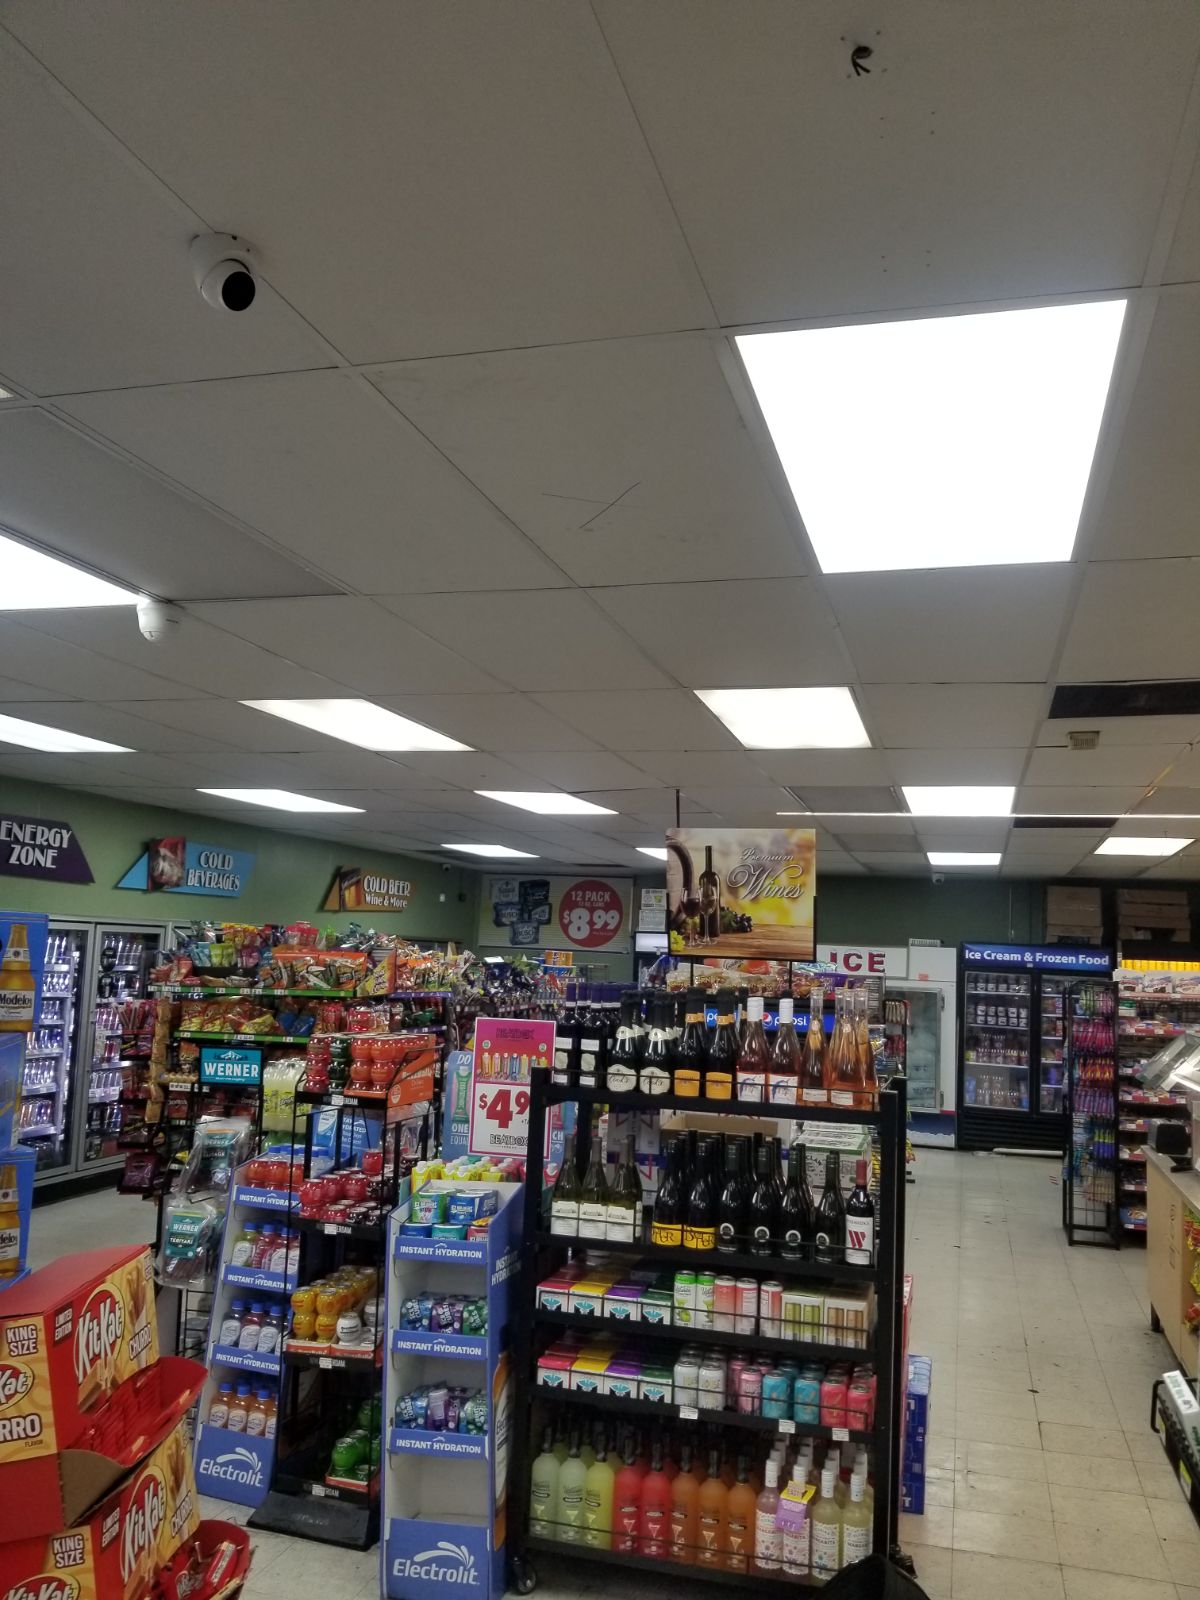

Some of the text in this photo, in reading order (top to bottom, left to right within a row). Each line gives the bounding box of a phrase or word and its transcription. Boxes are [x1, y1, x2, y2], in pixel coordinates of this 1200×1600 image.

[0, 821, 73, 848] ENERGY
[9, 844, 58, 868] ZONE
[200, 851, 234, 870] COLD
[739, 848, 794, 861] Premium
[187, 869, 240, 891] BEVERAGES
[364, 875, 411, 896] COLD BEER
[726, 864, 804, 900] Wines
[365, 893, 382, 906] Wine
[390, 896, 408, 908] More
[571, 890, 611, 902] 12 PACK
[829, 950, 886, 974] ICE
[965, 949, 1110, 965] Ice Cream & Frozen Food
[456, 1054, 472, 1065] DO
[204, 1062, 259, 1077] WERNER
[452, 1122, 469, 1134] ONE
[239, 1194, 266, 1203] INSTANT
[173, 1223, 200, 1233] WERNER
[400, 1245, 482, 1259] INSTANT HYDRATION
[227, 1274, 254, 1285] INSTANT
[55, 1308, 73, 1327] LIMITED
[6, 1325, 37, 1343] KING
[9, 1340, 37, 1357] SIZE
[398, 1341, 482, 1355] INSTANT HYDRATION
[215, 1353, 280, 1371] INSTANT HYDRATION
[396, 1439, 481, 1454] INSTANT HYDRATION
[199, 1457, 263, 1487] Electrolit
[53, 1535, 84, 1554] KING
[56, 1550, 84, 1568] SIZE
[393, 1558, 478, 1585] Electrolit
